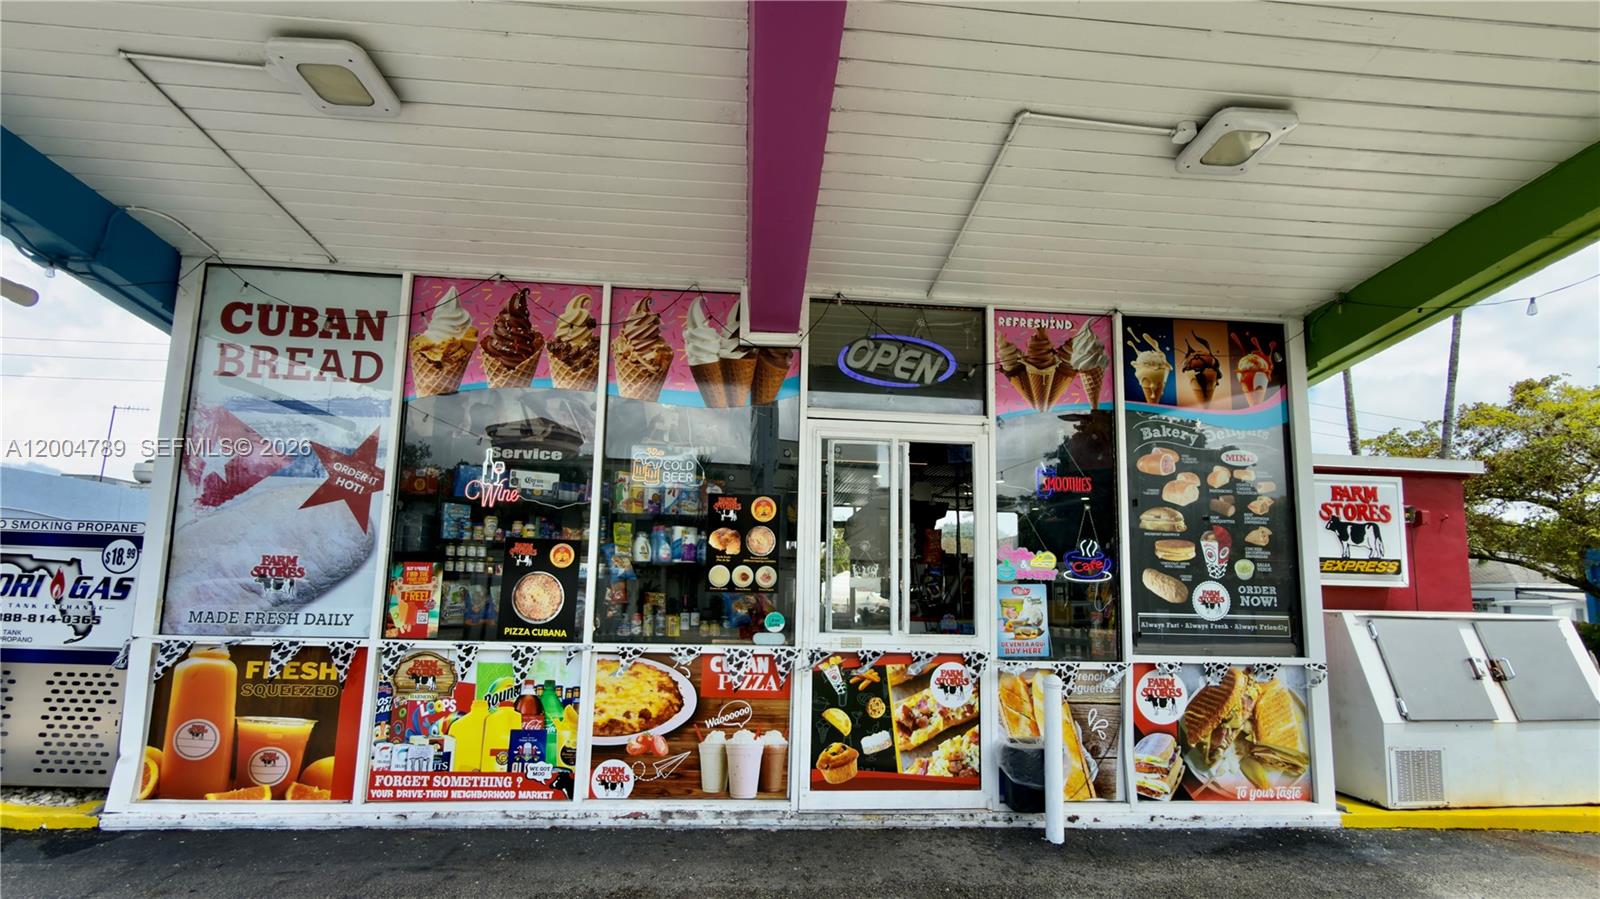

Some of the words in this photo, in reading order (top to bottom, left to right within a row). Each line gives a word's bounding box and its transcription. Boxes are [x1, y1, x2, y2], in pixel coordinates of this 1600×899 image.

[220, 301, 388, 341] CUBAN
[213, 342, 384, 384] BREAD
[846, 339, 946, 385] OPEN
[1140, 424, 1199, 446] Bakery
[491, 446, 563, 461] Service
[663, 460, 694, 472] COLD
[333, 462, 369, 482] ORDER
[368, 476, 380, 486] IT
[662, 471, 694, 483] BEER
[335, 476, 365, 495] HOT!
[1043, 476, 1093, 493] SMOOTHIES
[465, 478, 520, 507] Wine
[1330, 485, 1379, 503] FARM
[1319, 502, 1391, 523] STORES
[11, 520, 73, 531] SMOKING
[77, 522, 138, 533] PROPANE
[105, 547, 137, 566] $18.99
[261, 555, 299, 567] FARM
[250, 566, 306, 578] STORES
[1323, 560, 1399, 574] EXPRESS
[69, 575, 135, 600] GAS
[1238, 585, 1277, 595] ORDER
[404, 591, 429, 601] FREE!
[1239, 596, 1277, 607] NOW!
[0, 613, 102, 625] 88-814-0365
[188, 611, 239, 624] MADE
[244, 612, 299, 625] FRESH
[303, 613, 354, 627] DAILY
[504, 627, 530, 637] PIZZA
[532, 628, 567, 638] CUBANA
[1141, 621, 1165, 631] Always
[1185, 622, 1208, 632] Always
[1234, 623, 1258, 632] Always
[1259, 623, 1288, 633] Friendly
[940, 669, 964, 678] FARM
[1078, 672, 1106, 682] rench
[717, 674, 779, 691] PZZA
[1147, 677, 1175, 688] FARM
[240, 683, 339, 698] SQUEEZED
[1141, 687, 1183, 698] STORES
[419, 699, 457, 717] LOOPS
[601, 766, 625, 775] FARM
[374, 775, 430, 788] FORGET
[432, 776, 513, 789] SOMETHING
[516, 777, 524, 788] ?
[595, 773, 630, 783] STORES
[371, 789, 394, 799] YOUR
[396, 789, 448, 800] DRIVE-THRU
[450, 790, 516, 801] NEIGHBORHOOD
[518, 790, 554, 800] MARKET
